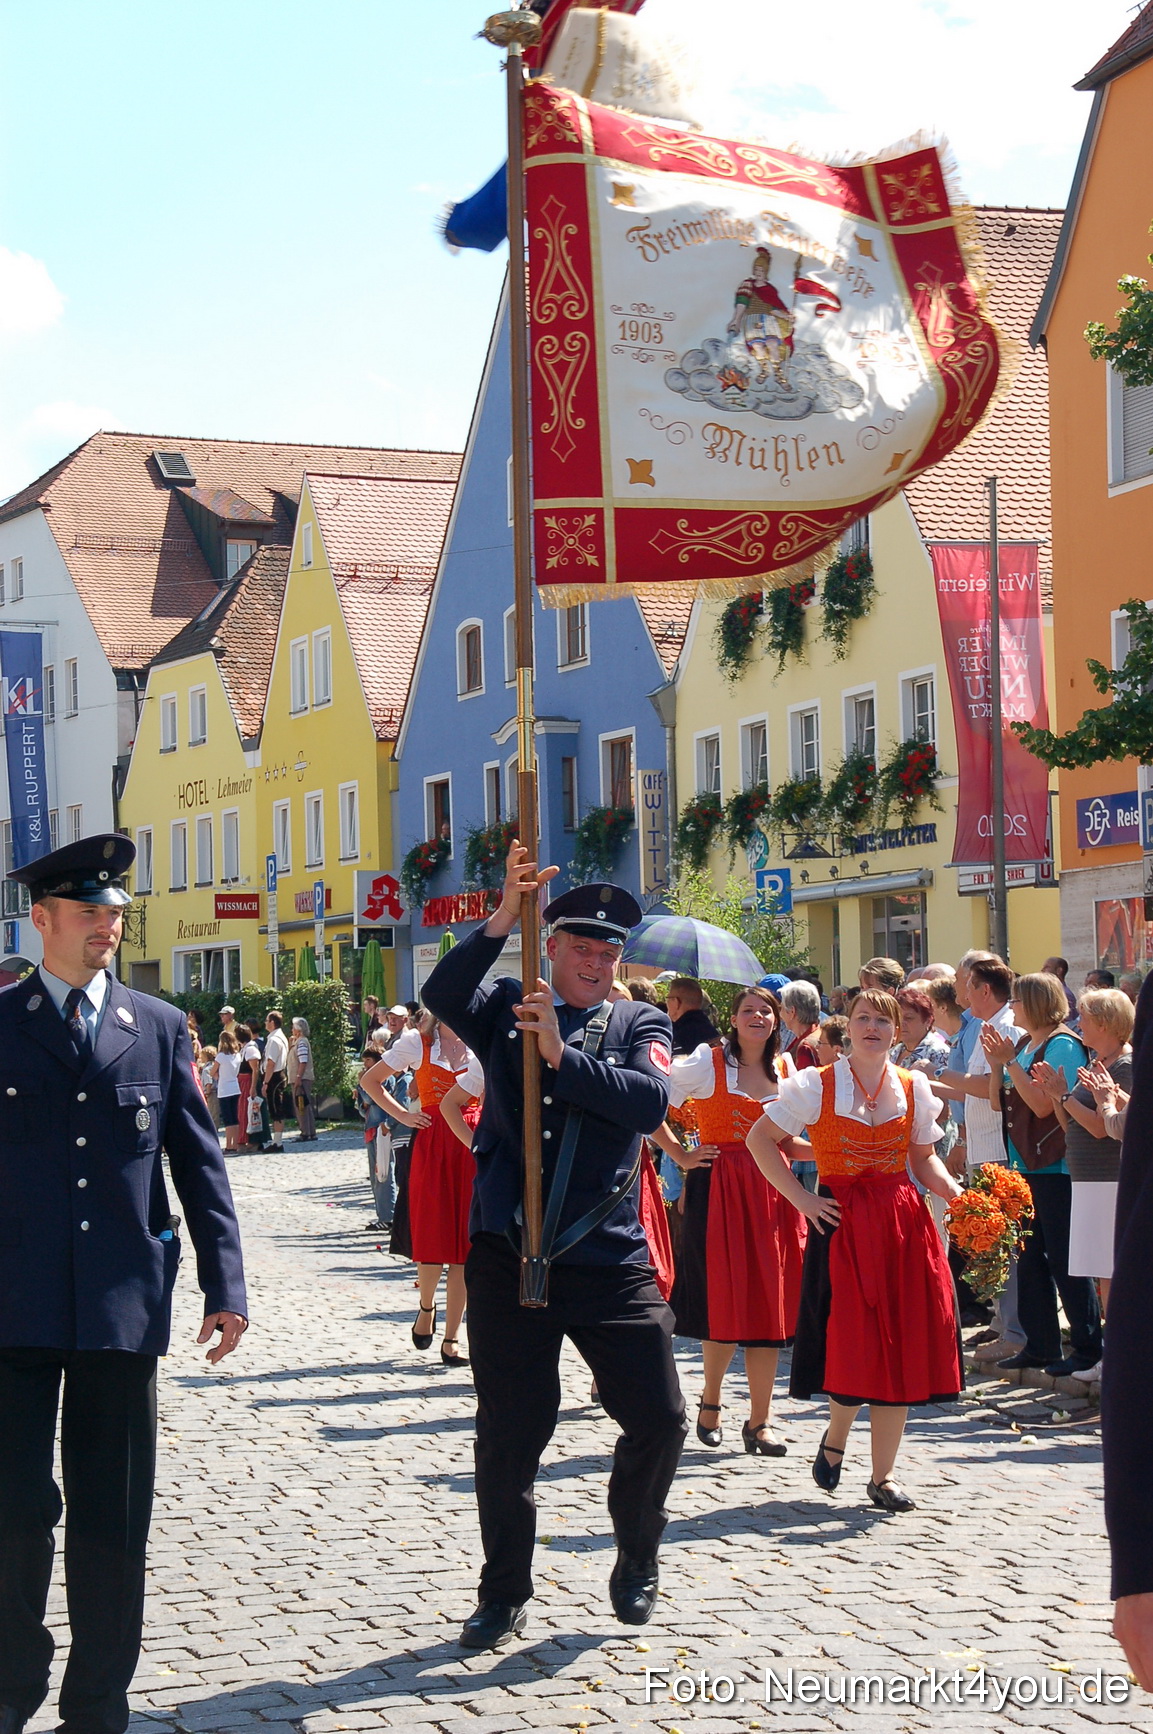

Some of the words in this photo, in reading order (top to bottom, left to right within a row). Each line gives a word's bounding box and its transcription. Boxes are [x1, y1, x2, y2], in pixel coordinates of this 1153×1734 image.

[618, 319, 664, 344] 1903
[701, 422, 845, 486] Mühlen
[22, 722, 39, 806] RUPPERT
[178, 779, 209, 810] HOTEL
[217, 773, 252, 799] Lehmeier
[29, 808, 42, 842] K&L
[645, 793, 663, 883] WITTL
[1084, 809, 1111, 833] DER
[216, 901, 258, 911] WISSMACH
[177, 919, 221, 940] Restaurant
